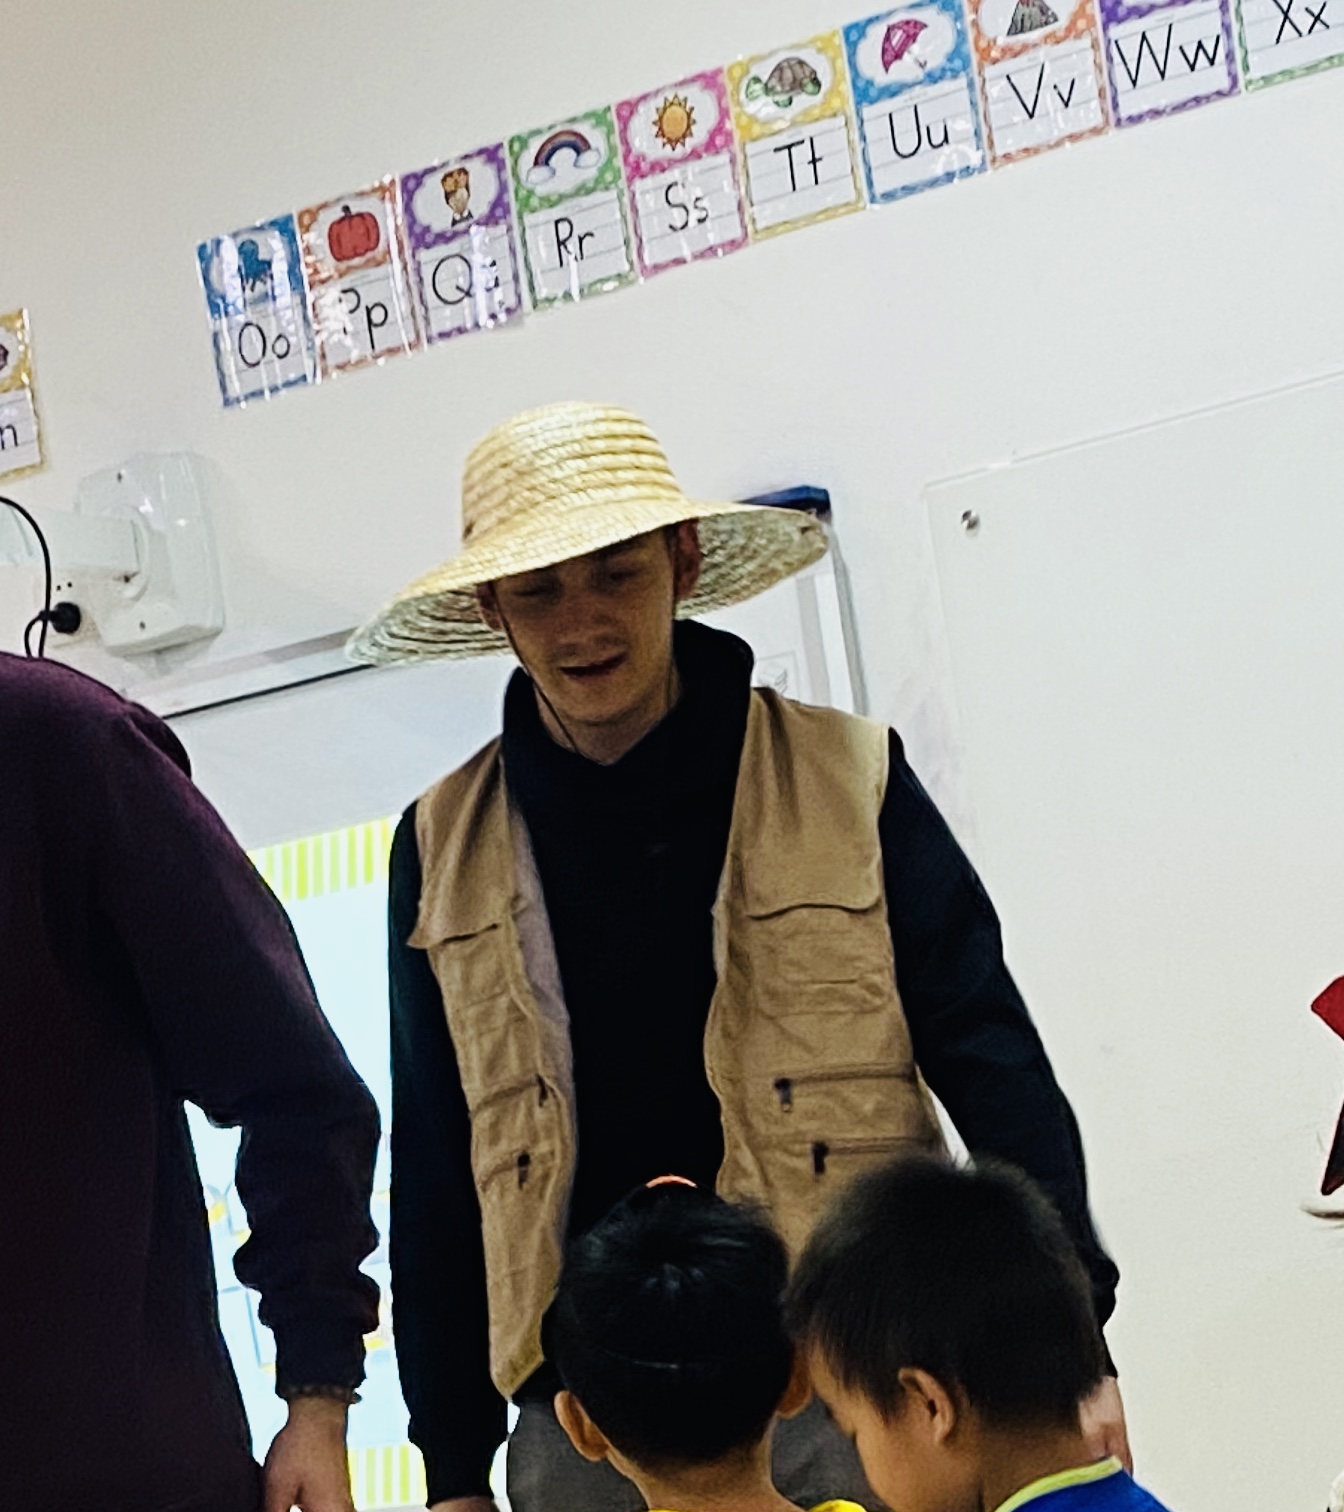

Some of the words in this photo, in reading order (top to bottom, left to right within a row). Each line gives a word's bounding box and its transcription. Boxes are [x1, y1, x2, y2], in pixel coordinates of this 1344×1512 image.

[238, 322, 290, 368] Oo
[554, 217, 595, 269] Rr
[665, 181, 709, 232] Ss
[774, 137, 824, 192] Tt
[888, 105, 949, 159] Uu
[1006, 62, 1076, 121] Vv
[1114, 22, 1221, 89] Ww
[1273, 0, 1330, 44] Xx
